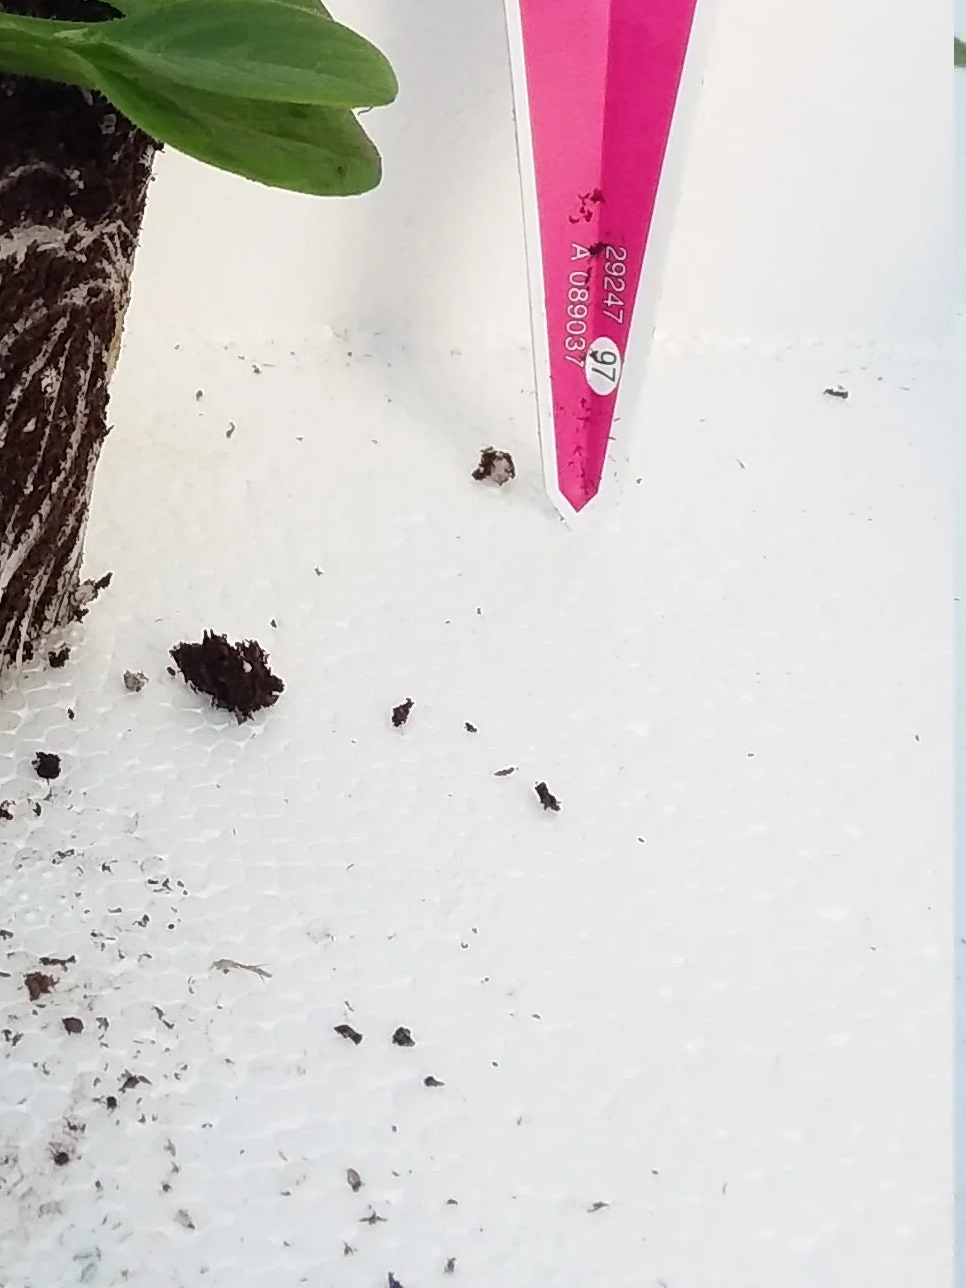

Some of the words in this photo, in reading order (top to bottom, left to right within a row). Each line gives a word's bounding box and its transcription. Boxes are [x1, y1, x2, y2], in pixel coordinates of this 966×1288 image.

[570, 243, 590, 261] A
[602, 246, 628, 324] 29247
[591, 351, 617, 383] 97
